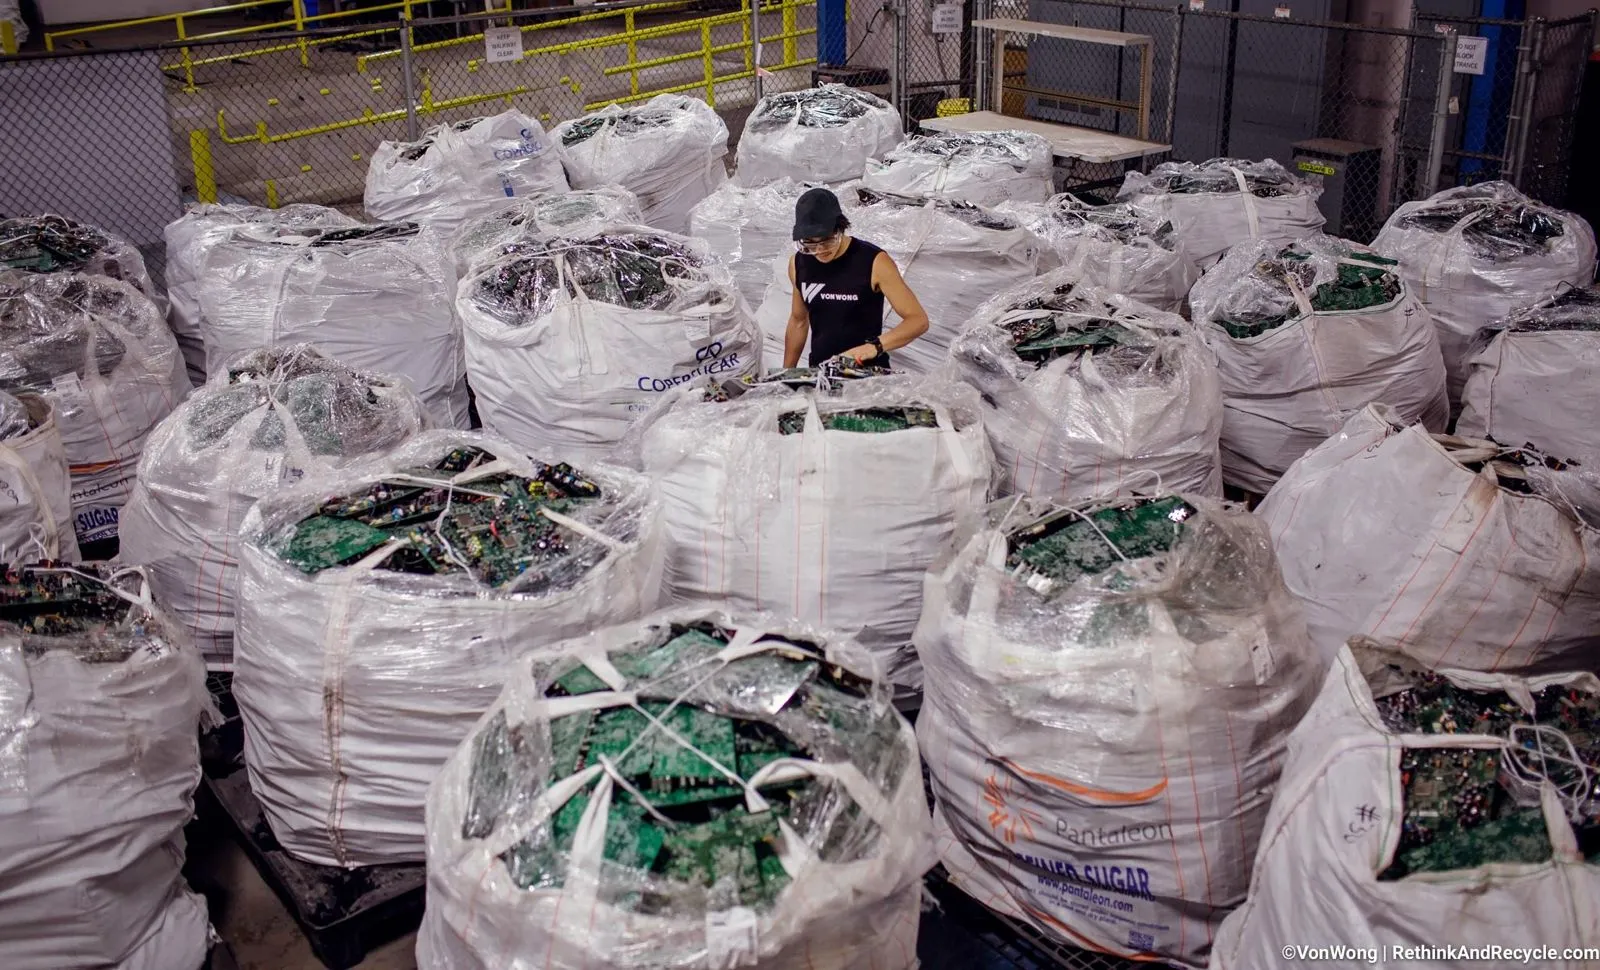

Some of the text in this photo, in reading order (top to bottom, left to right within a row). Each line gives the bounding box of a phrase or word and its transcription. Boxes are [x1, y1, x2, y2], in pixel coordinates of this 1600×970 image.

[1456, 61, 1478, 69] TRANCE
[71, 477, 129, 500] ntaleon
[1056, 817, 1174, 846] Pantaleon
[1037, 874, 1133, 912] www.pantaleon.com
[1084, 865, 1155, 900] SUGAR
